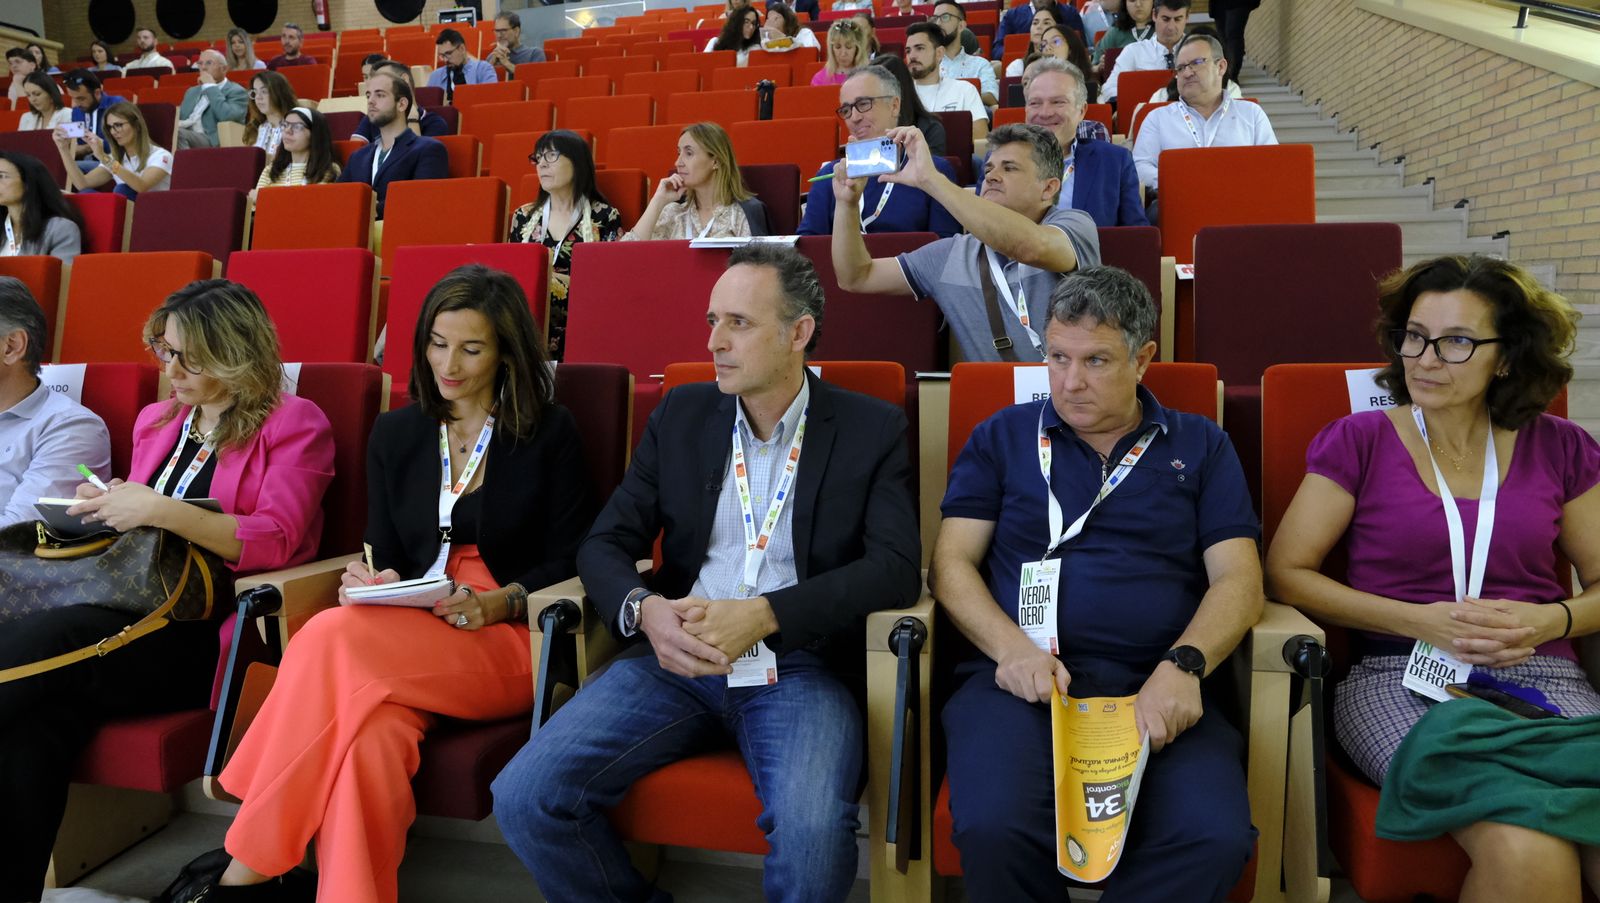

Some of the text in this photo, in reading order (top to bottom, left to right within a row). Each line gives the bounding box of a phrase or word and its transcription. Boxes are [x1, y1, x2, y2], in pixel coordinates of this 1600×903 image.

[1022, 567, 1034, 586] IN
[1021, 584, 1051, 606] VERDA
[1417, 640, 1434, 656] IN
[1409, 664, 1445, 689] DERO
[1414, 652, 1456, 683] VERDA
[1070, 755, 1102, 768] natural
[1103, 752, 1129, 765] forma
[1084, 793, 1121, 818] 34
